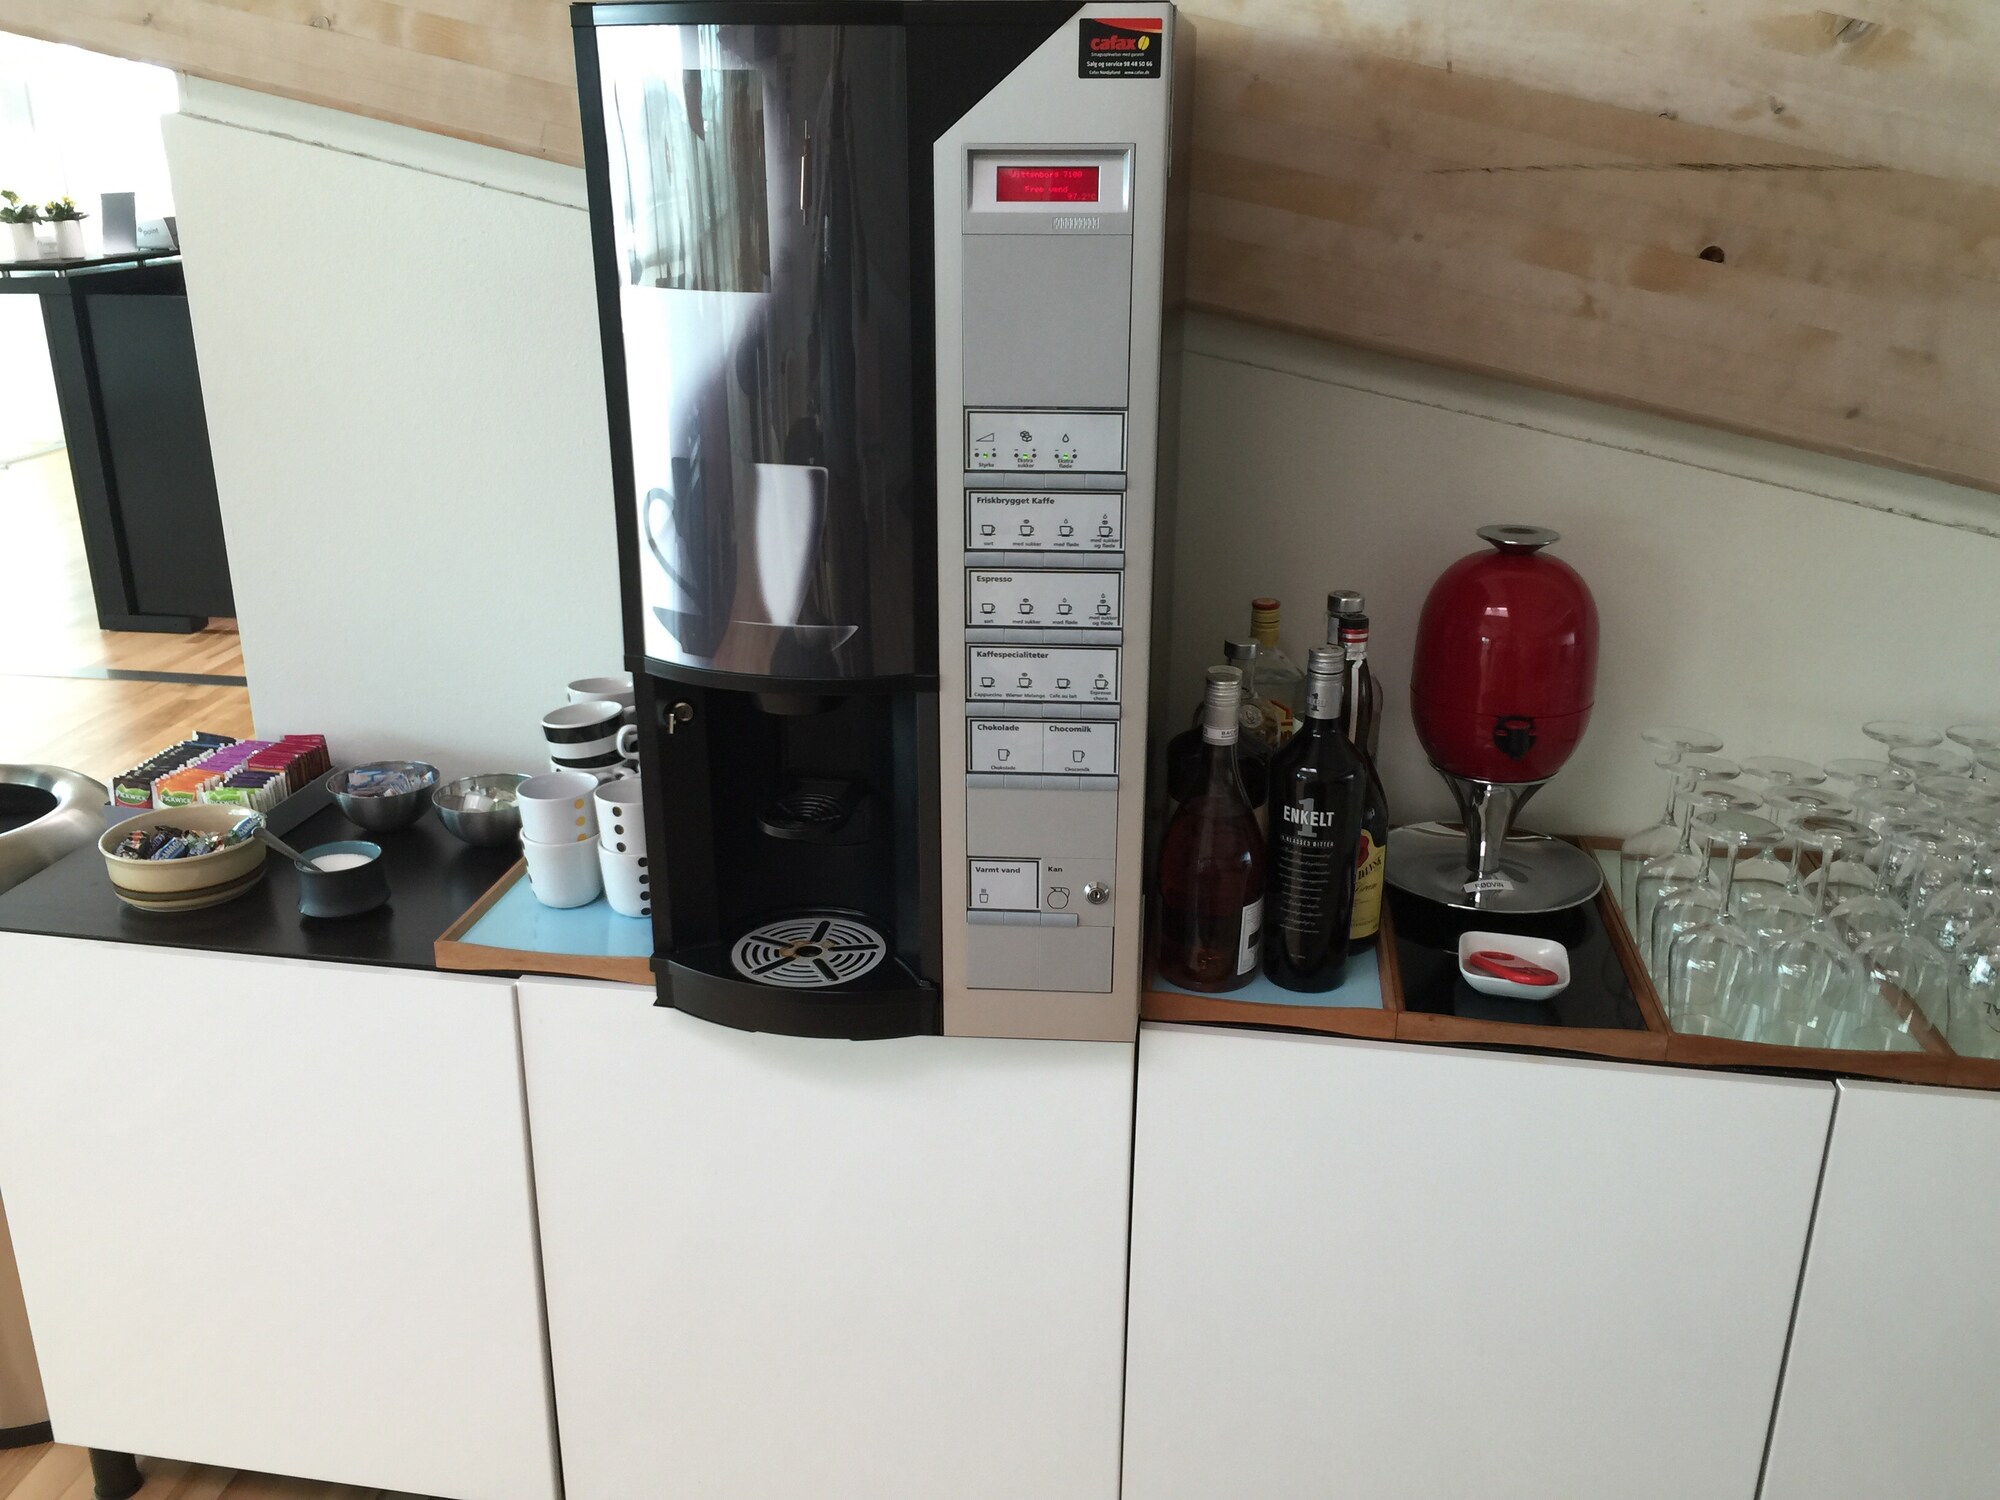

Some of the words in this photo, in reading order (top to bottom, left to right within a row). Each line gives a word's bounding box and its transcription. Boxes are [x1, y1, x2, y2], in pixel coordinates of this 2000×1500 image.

[1090, 35, 1136, 50] cafax
[977, 497, 1029, 505] Friskbrygget
[977, 651, 1048, 659] Kaffespecialiteter
[116, 790, 147, 802] PICKWICK
[161, 795, 192, 804] PICKWICK
[1283, 805, 1335, 827] ENKELT
